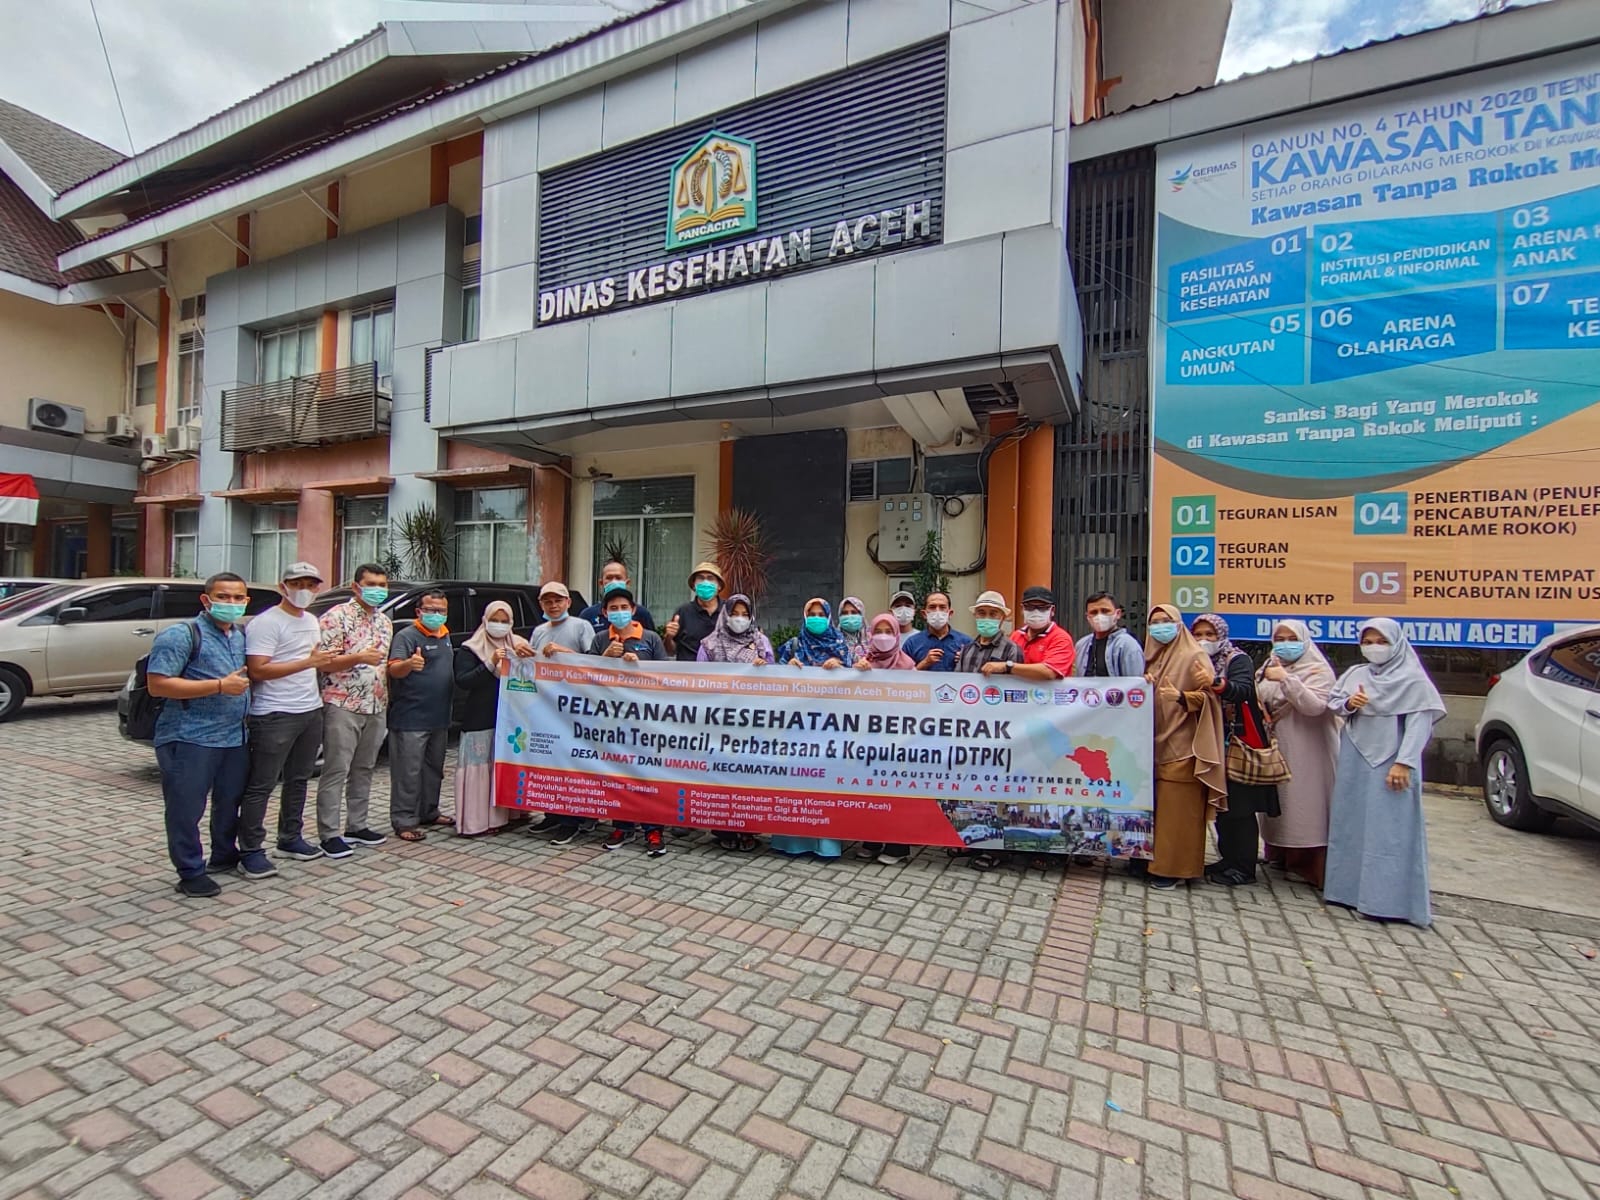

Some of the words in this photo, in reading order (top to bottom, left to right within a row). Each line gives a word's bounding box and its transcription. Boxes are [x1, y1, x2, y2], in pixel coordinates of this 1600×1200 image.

[1252, 130, 1324, 158] QANUN
[1333, 123, 1367, 142] NO.
[1376, 117, 1387, 132] 4
[1394, 99, 1472, 128] TAHUN
[1480, 87, 1537, 111] 2020
[1252, 116, 1483, 188] KAWASAN
[1495, 91, 1600, 140] TAN
[1192, 161, 1237, 177] GERMAS
[1251, 184, 1296, 201] SETIAP
[1301, 173, 1352, 191] ORANG
[1357, 158, 1433, 182] DILARANG
[1439, 142, 1519, 168] MEROKOK
[1251, 193, 1362, 225] Kawasan
[1372, 176, 1457, 202] Tanpa
[1468, 156, 1558, 187] Rokok
[677, 215, 740, 241] PANCACITA
[1512, 206, 1549, 229] 03
[1271, 234, 1302, 255] 01
[1321, 231, 1353, 253] 02
[1512, 226, 1589, 249] ARENA
[540, 279, 616, 323] DINAS
[627, 227, 812, 303] KESEHATAN
[828, 199, 932, 258] ACEH
[1321, 253, 1389, 273] INSTITUSI
[1393, 238, 1490, 263] PENDIDIKAN
[1512, 246, 1577, 267] ANAK
[1181, 260, 1255, 283] FASILITAS
[1321, 269, 1381, 286] FORMAL
[1384, 266, 1395, 277] &
[1398, 255, 1480, 275] INFORMAL
[1181, 272, 1272, 298] PELAYANAN
[1512, 282, 1550, 305] 07
[1180, 288, 1270, 312] KESEHATAN
[1269, 313, 1300, 334] 05
[1319, 307, 1353, 328] 06
[1382, 313, 1456, 335] ARENA
[1180, 339, 1276, 362] ANGKUTAN
[1337, 332, 1456, 357] OLAHRAGA
[1180, 360, 1235, 377] UMUM
[1264, 406, 1326, 424] Sanksi
[1334, 402, 1378, 420] Bagi
[1386, 400, 1436, 415] Yang
[1444, 389, 1539, 411] Merokok
[1187, 435, 1203, 449] di
[1209, 431, 1288, 448] Kawasan
[1296, 427, 1355, 442] Tanpa
[1363, 419, 1426, 437] Rokok
[1434, 412, 1522, 432] Meliputi
[1414, 488, 1527, 504] PENERTIBAN
[1176, 504, 1210, 526] 01
[1218, 507, 1288, 520] TEGURAN
[1292, 506, 1337, 519] LISAN
[1359, 501, 1401, 525] 04
[1413, 523, 1497, 537] REKLAME
[1503, 521, 1577, 536] ROKOK)
[1176, 545, 1209, 566] 02
[1219, 542, 1289, 554] TEGURAN
[1219, 557, 1286, 569] TERTULIS
[1359, 571, 1400, 594] 05
[1413, 569, 1518, 582] PENUTUPAN
[1522, 569, 1595, 582] TEMPAT
[1175, 587, 1209, 608] 03
[1218, 593, 1300, 605] PENYITAAN
[1305, 594, 1334, 605] KTP
[1413, 586, 1530, 599] PENCABUTAN
[1536, 587, 1572, 599] IZIN
[1467, 623, 1537, 644] ACEH
[541, 666, 563, 678] Dinas
[566, 670, 614, 682] Kesehatan
[662, 677, 689, 688] Aceh
[698, 678, 729, 689] Dinas
[731, 680, 789, 692] Kesehatan
[792, 683, 850, 696] Kabupaten
[854, 685, 882, 696] Aceh
[886, 687, 926, 700] Tengah
[558, 695, 698, 724] PELAYANAN
[704, 706, 860, 733] KESEHATAN
[867, 715, 1012, 740] BERGERAK
[573, 721, 626, 744] Daerah
[630, 728, 715, 754] Terpencil,
[720, 734, 820, 757] Perbatasan
[825, 740, 837, 758] &
[842, 741, 942, 766] Kepulauan
[947, 746, 1012, 772] (DTPK)
[571, 748, 598, 760] DESA
[600, 751, 636, 764] JAMAT
[638, 755, 662, 767] DAN
[664, 759, 710, 772] UMANG,
[713, 762, 787, 776] KECAMATAN
[790, 767, 826, 778] LINGE
[528, 781, 569, 792] Penyuluhan
[570, 785, 606, 796] Kesehatan
[529, 772, 562, 783] Pelayanan
[564, 776, 600, 786] Kesehatan
[837, 777, 960, 790] KABUPATEN
[974, 783, 1026, 794] ACEH
[1037, 786, 1122, 798] TENGAH
[872, 769, 887, 777] 30
[891, 770, 950, 780] AGUSTUS
[956, 772, 978, 782] S/D
[984, 774, 999, 782] 04
[1006, 775, 1082, 786] SEPTEMBER
[1088, 778, 1121, 788] 2021
[526, 790, 555, 802] Skrining
[690, 790, 730, 800] Pelayanan
[731, 793, 772, 804] Kesehatan
[774, 796, 803, 806] Telinga
[804, 798, 836, 808] (Komda
[837, 800, 866, 809] PGPKT
[868, 802, 892, 812] Aceh)
[597, 808, 608, 816] Kit
[690, 799, 730, 810] Pelayanan
[731, 802, 772, 812] Kesehatan
[774, 805, 790, 815] Gigi
[792, 807, 798, 815] &
[800, 808, 823, 816] Mulut
[690, 808, 730, 819] Pelayanan
[768, 814, 830, 825] Echocardiografi
[691, 816, 726, 826] Pelatihan
[728, 820, 746, 828] BHD
